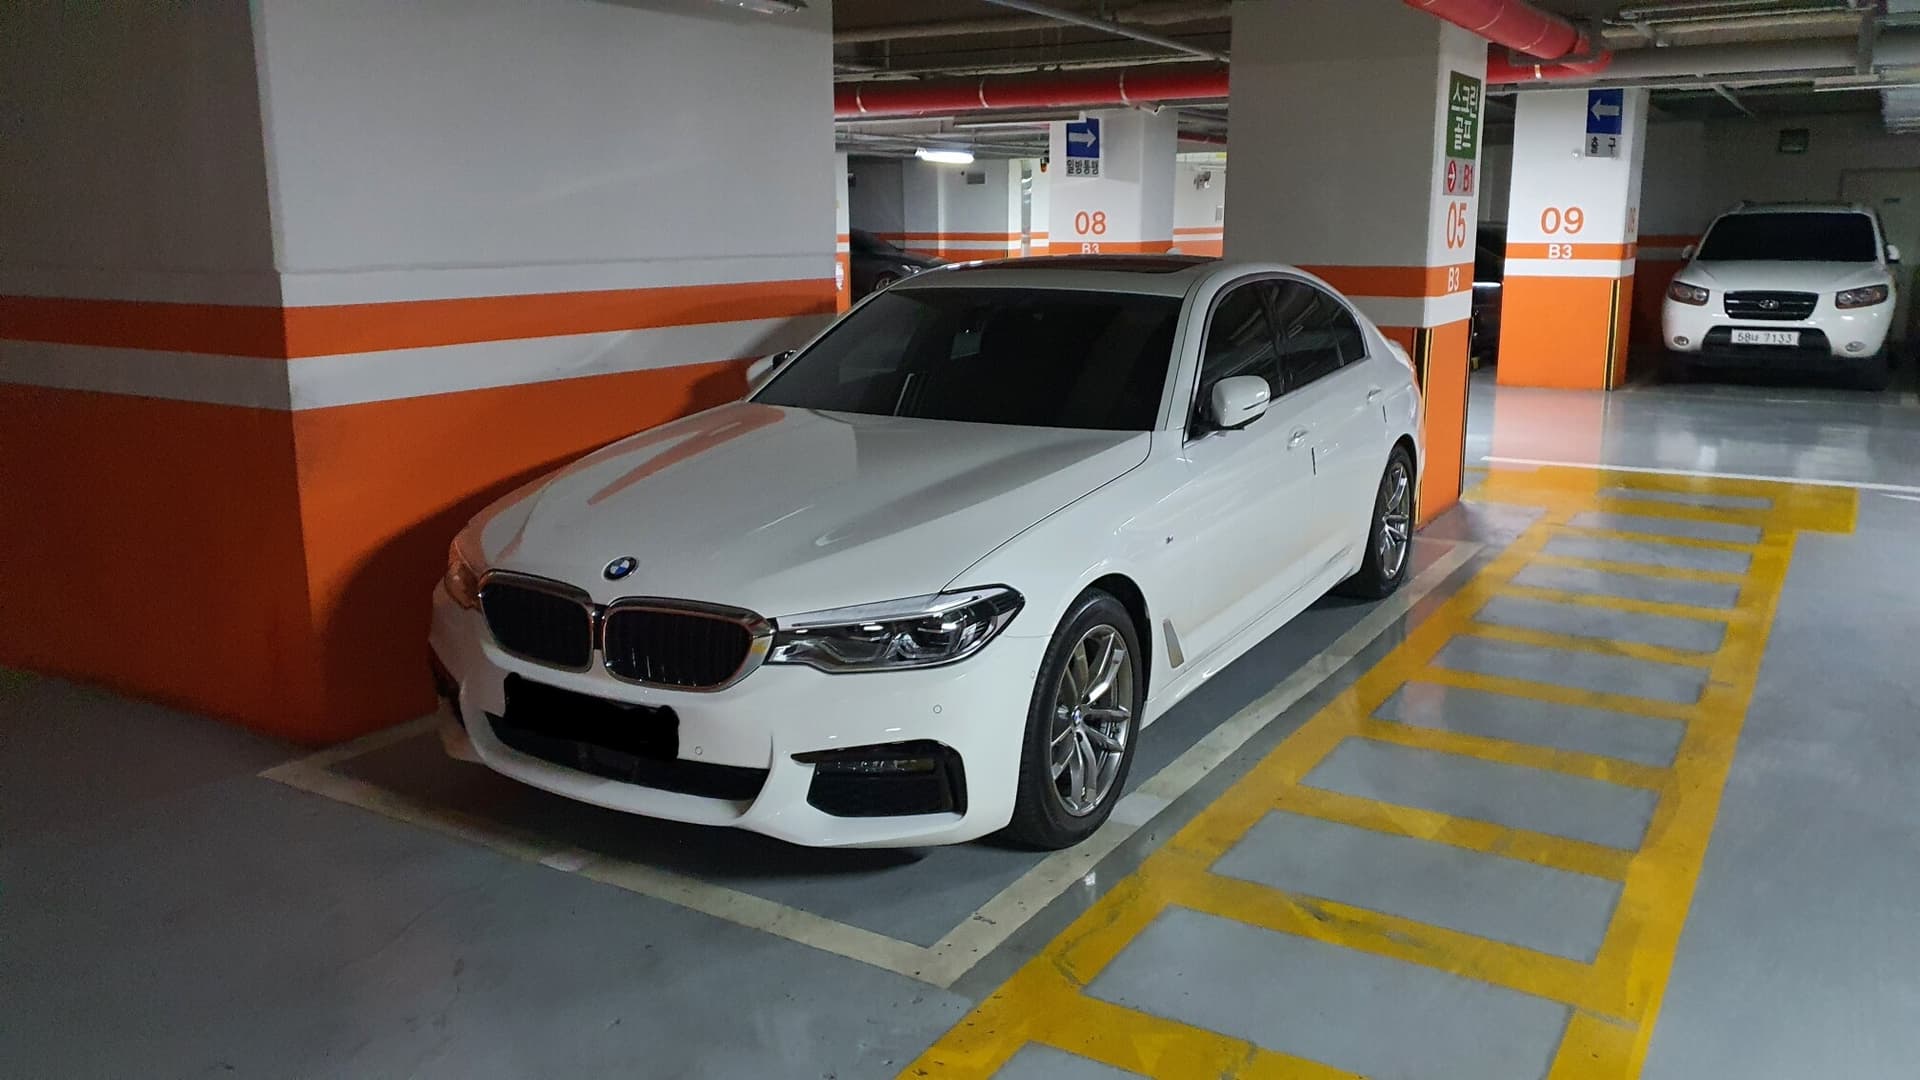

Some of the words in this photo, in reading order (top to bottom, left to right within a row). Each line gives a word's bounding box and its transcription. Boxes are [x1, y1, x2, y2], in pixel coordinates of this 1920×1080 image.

[1450, 81, 1479, 119] 스크린
[1453, 116, 1472, 151] 골프
[1590, 136, 1616, 155] 출구
[1066, 159, 1099, 175] 일방통행
[1463, 164, 1473, 192] B1
[1075, 211, 1106, 235] 08
[1447, 201, 1467, 249] 05
[1541, 207, 1584, 234] 09
[1082, 243, 1100, 254] B3
[1549, 244, 1573, 259] B3
[1447, 267, 1460, 292] B3
